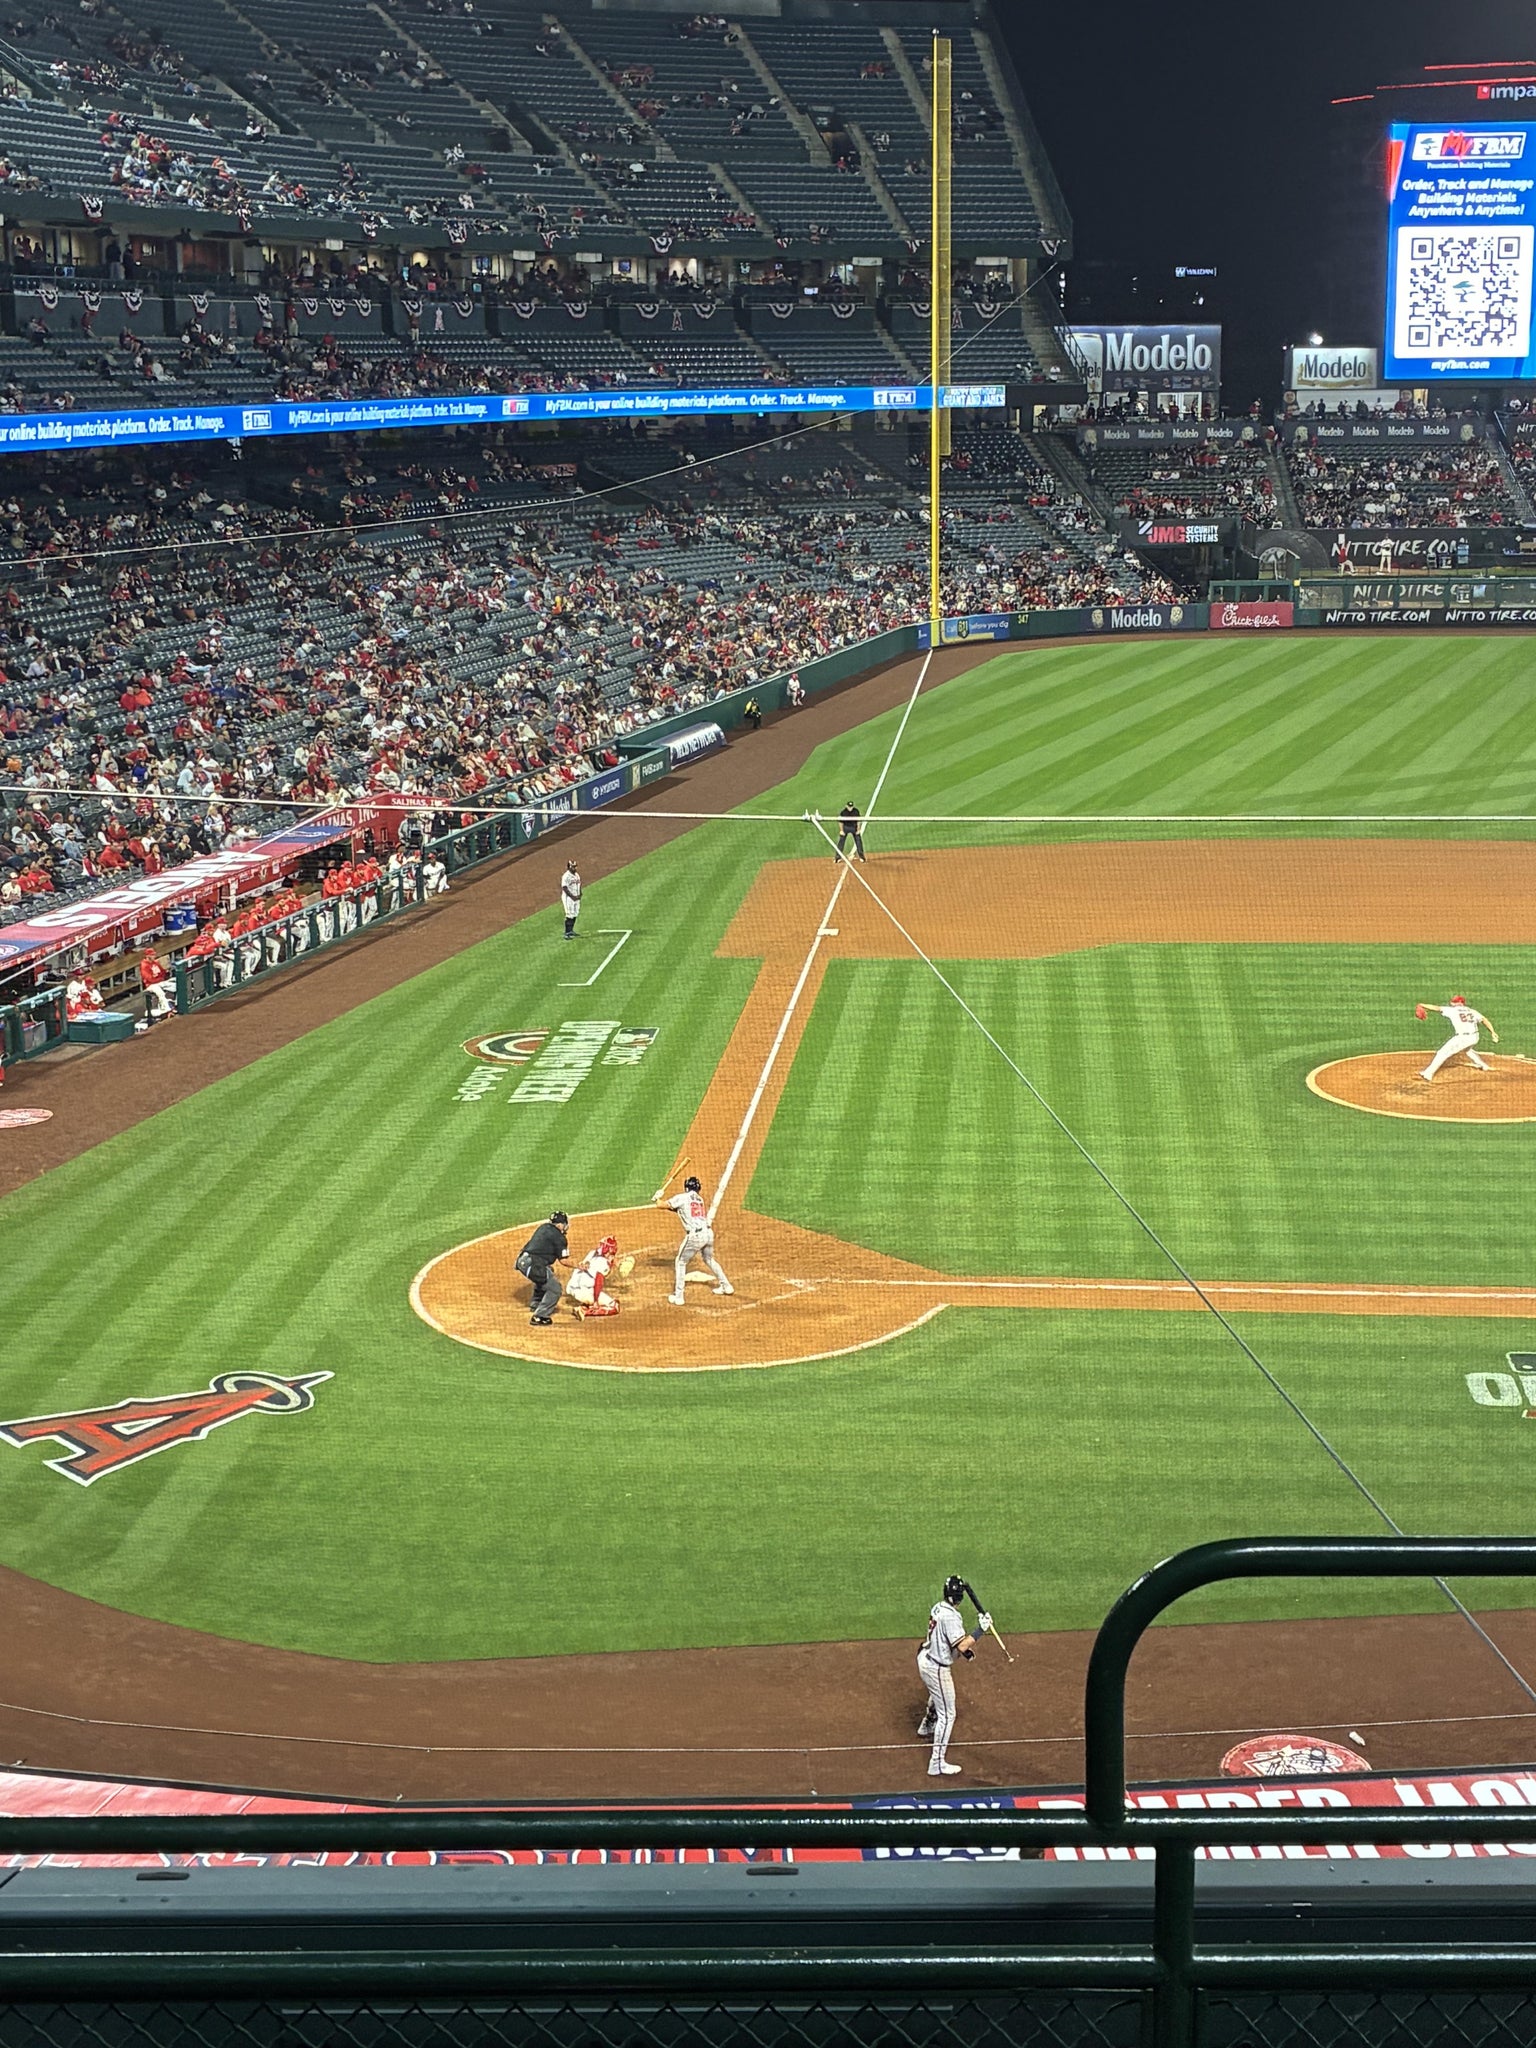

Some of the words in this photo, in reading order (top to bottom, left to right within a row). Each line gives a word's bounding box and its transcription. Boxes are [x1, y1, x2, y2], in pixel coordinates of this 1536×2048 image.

[1402, 180, 1435, 192] Order,
[1438, 179, 1467, 190] Track
[1468, 179, 1490, 190] and
[1490, 180, 1534, 192] Manage
[1418, 193, 1464, 205] Building
[1466, 192, 1517, 204] Materials
[1408, 206, 1464, 218] Anywhere
[1465, 206, 1474, 216] &
[1475, 204, 1525, 218] Anytime!
[1105, 332, 1212, 372] Modelo
[1303, 354, 1366, 379] Modelo
[635, 396, 668, 411] building
[670, 395, 707, 408] materials
[708, 394, 748, 409] platform.
[750, 394, 778, 406] Order.
[780, 394, 806, 405] Track.
[807, 393, 847, 407] Manage.
[38, 421, 72, 443] building
[73, 419, 111, 438] materials
[1104, 429, 1130, 440] Modelo
[1138, 429, 1165, 440] Modelo
[1172, 428, 1199, 439] Modelo
[1206, 428, 1233, 439] Modelo
[1317, 426, 1345, 437] Modelo
[1352, 425, 1380, 437] Modelo
[1387, 425, 1415, 437] Modelo
[1423, 425, 1450, 437] Modelo
[1148, 526, 1186, 544] JMG
[1185, 525, 1219, 535] SECURITY
[1185, 534, 1219, 544] SYSTEMS
[1111, 608, 1162, 629] Modelo
[1325, 609, 1366, 622] NITTO
[1369, 609, 1430, 623] TIRE.COM
[1445, 609, 1486, 622] NITTO
[451, 1065, 509, 1102] Adobe
[507, 1068, 593, 1104] WEEK
